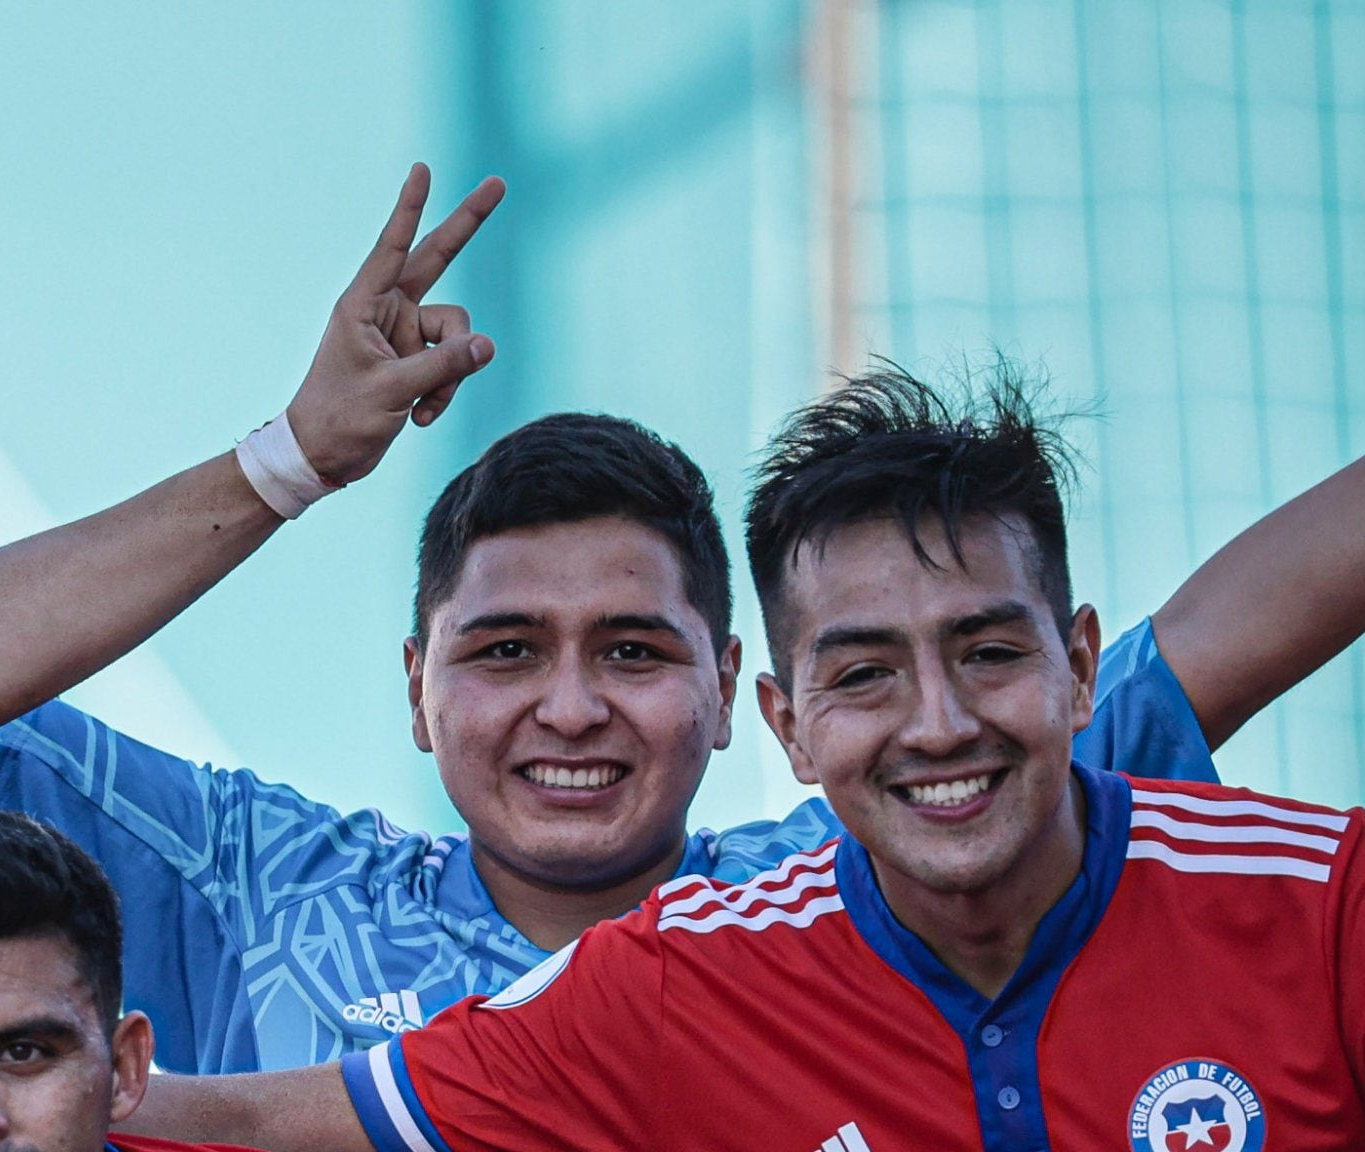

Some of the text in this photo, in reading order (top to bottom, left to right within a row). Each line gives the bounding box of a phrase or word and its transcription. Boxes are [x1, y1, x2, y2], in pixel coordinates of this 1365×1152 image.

[342, 1003, 417, 1033] adid
[1132, 1063, 1261, 1139] FEDERACION DE FUTBOL
